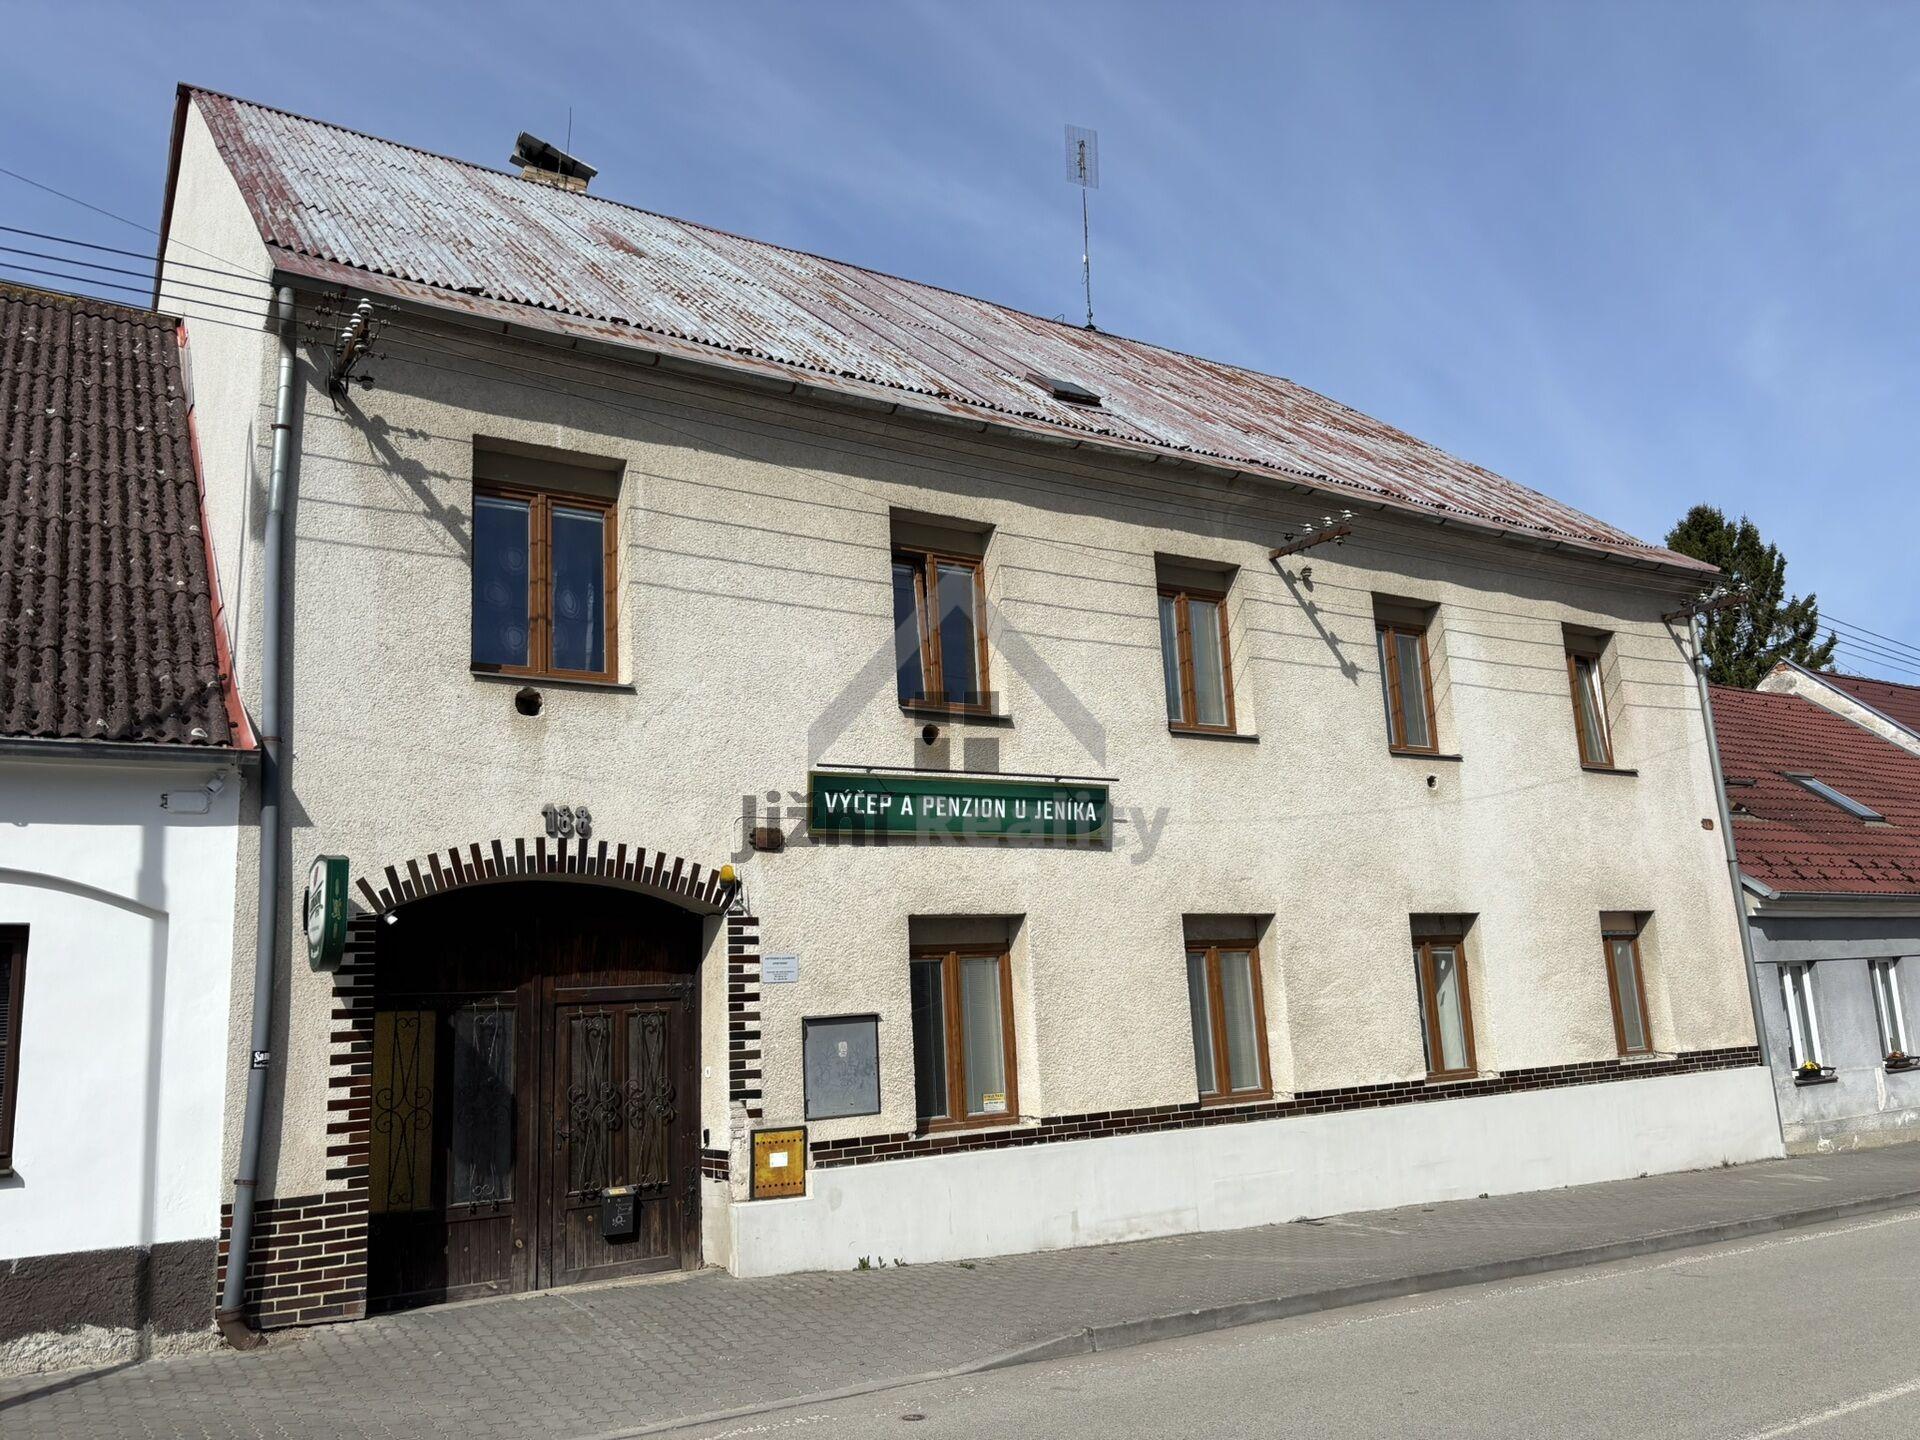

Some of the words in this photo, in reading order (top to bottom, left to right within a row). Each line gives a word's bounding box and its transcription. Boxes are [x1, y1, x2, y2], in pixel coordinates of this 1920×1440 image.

[542, 803, 591, 837] 188
[824, 789, 892, 815] VÝČEP
[900, 794, 914, 816] A
[922, 795, 1006, 819] PENZION
[1014, 799, 1027, 819] U
[1034, 797, 1097, 821] JENÍKA
